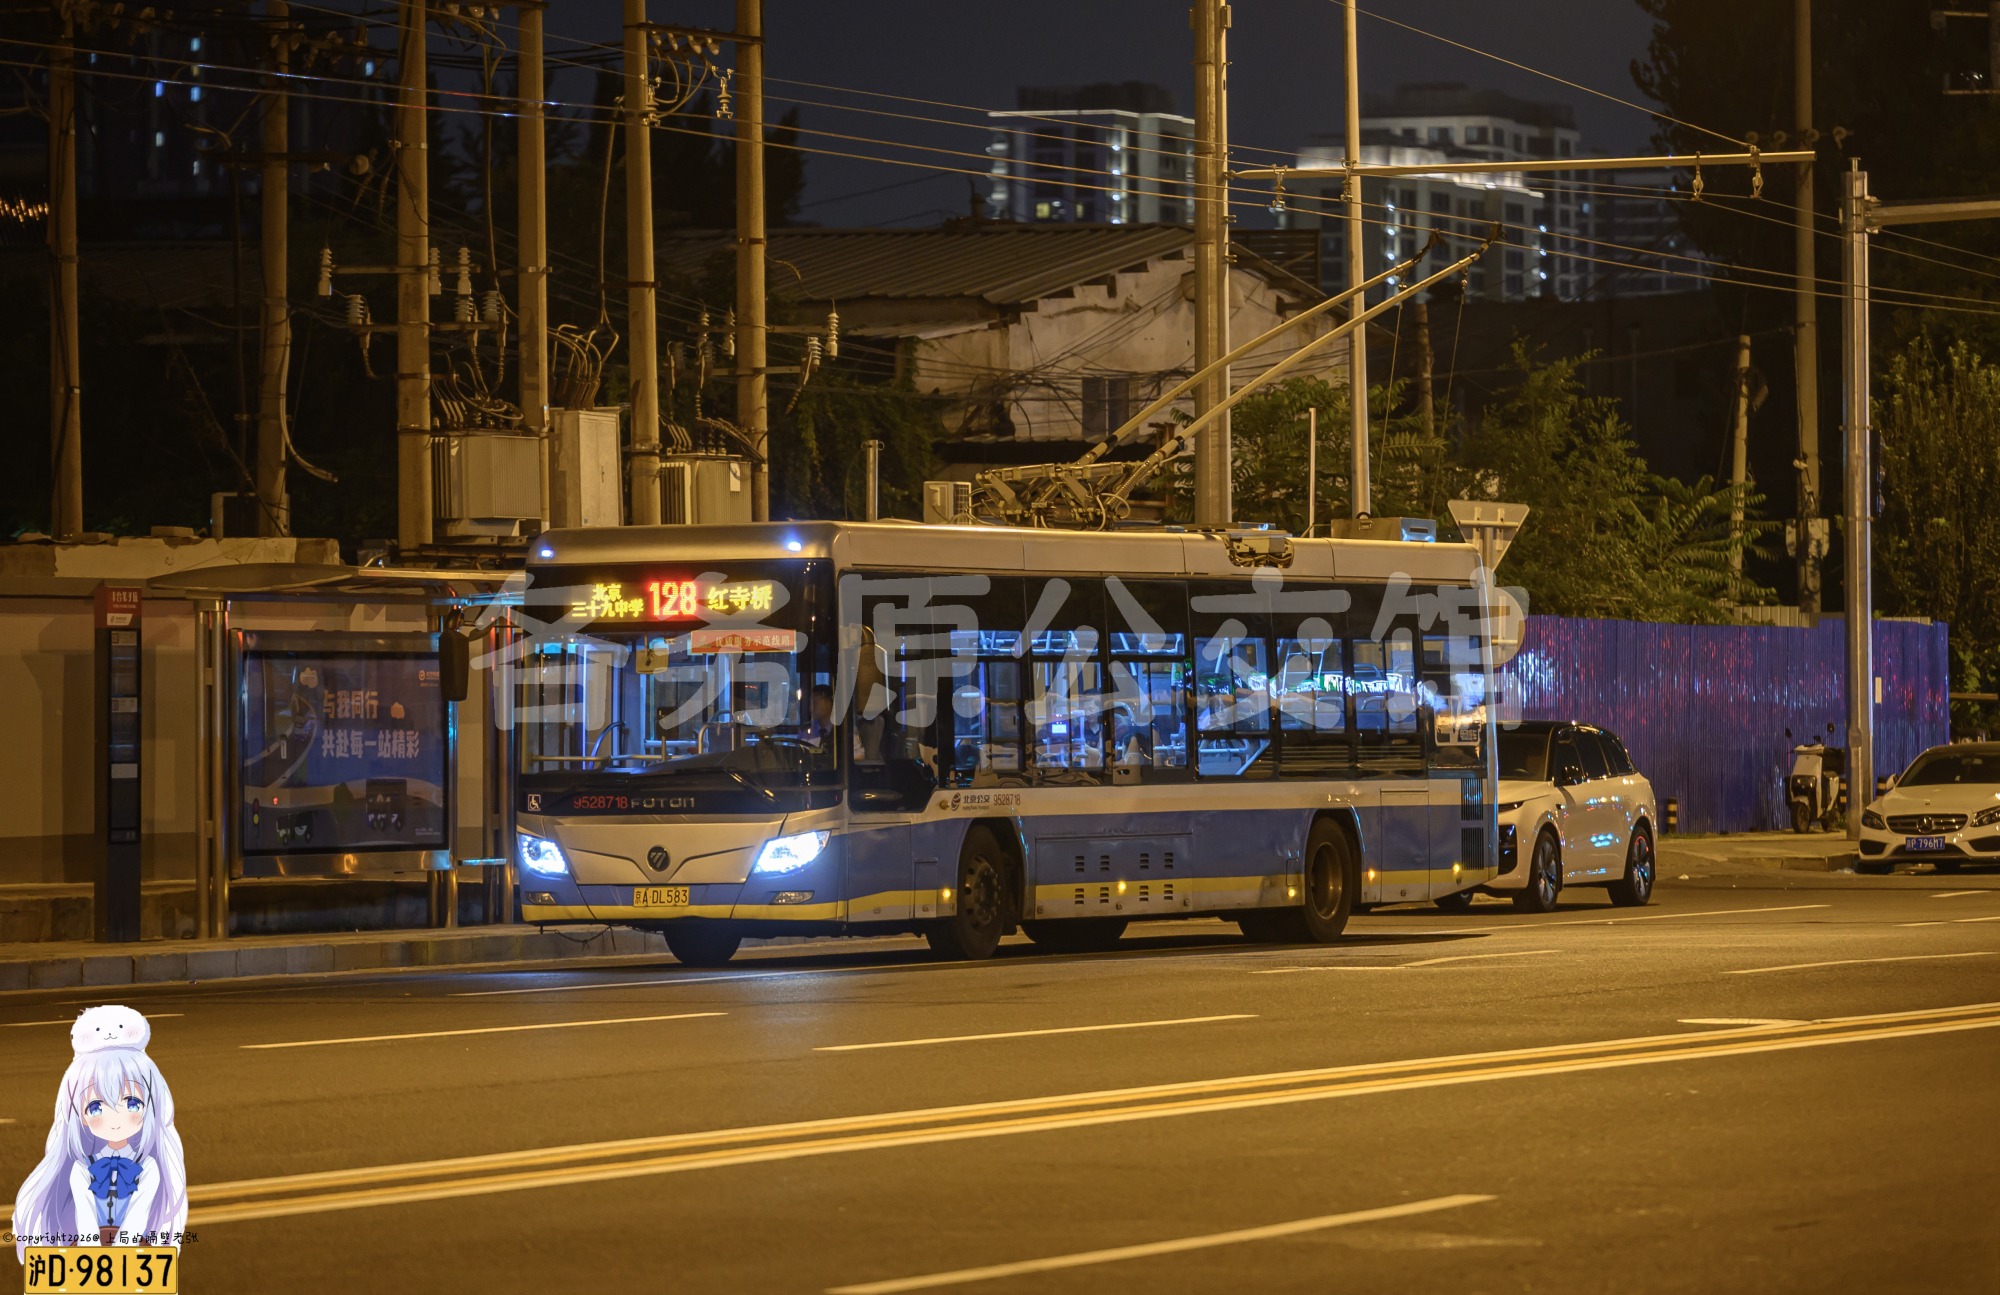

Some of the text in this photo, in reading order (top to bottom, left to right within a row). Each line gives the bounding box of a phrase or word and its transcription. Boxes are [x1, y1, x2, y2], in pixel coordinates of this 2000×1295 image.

[592, 584, 621, 600] 北京
[649, 581, 697, 616] 128
[708, 584, 773, 611] 红寺桥
[571, 599, 644, 618] 三十九中学
[323, 690, 379, 719] 与我同行
[322, 729, 420, 759] 共赴每一站精彩
[573, 795, 695, 809] 9528718 FOTON
[963, 793, 1021, 806] 北京公交 9528718
